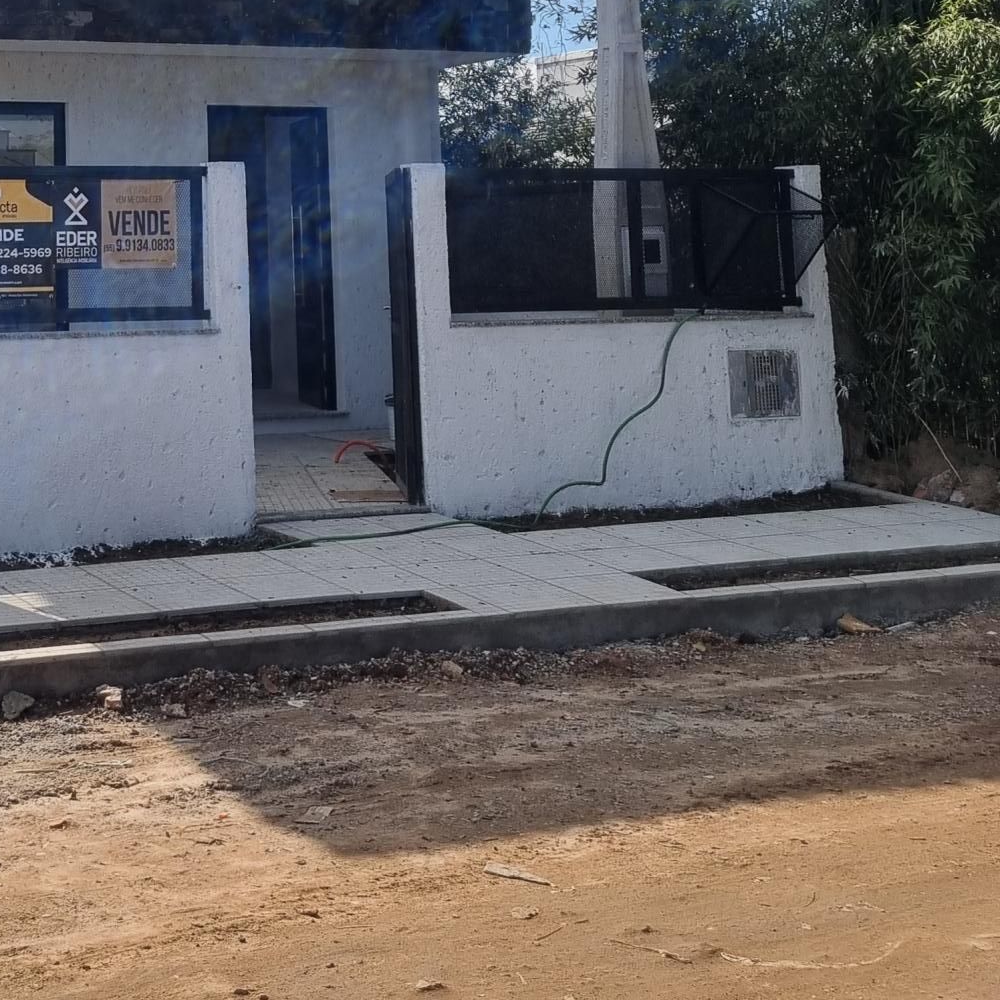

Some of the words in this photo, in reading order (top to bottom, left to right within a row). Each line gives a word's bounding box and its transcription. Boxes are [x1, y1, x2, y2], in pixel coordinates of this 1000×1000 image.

[108, 210, 170, 236] VENDE
[56, 231, 97, 246] EDER
[116, 238, 175, 252] 9.9134.0833
[56, 247, 97, 257] RIBEIRO
